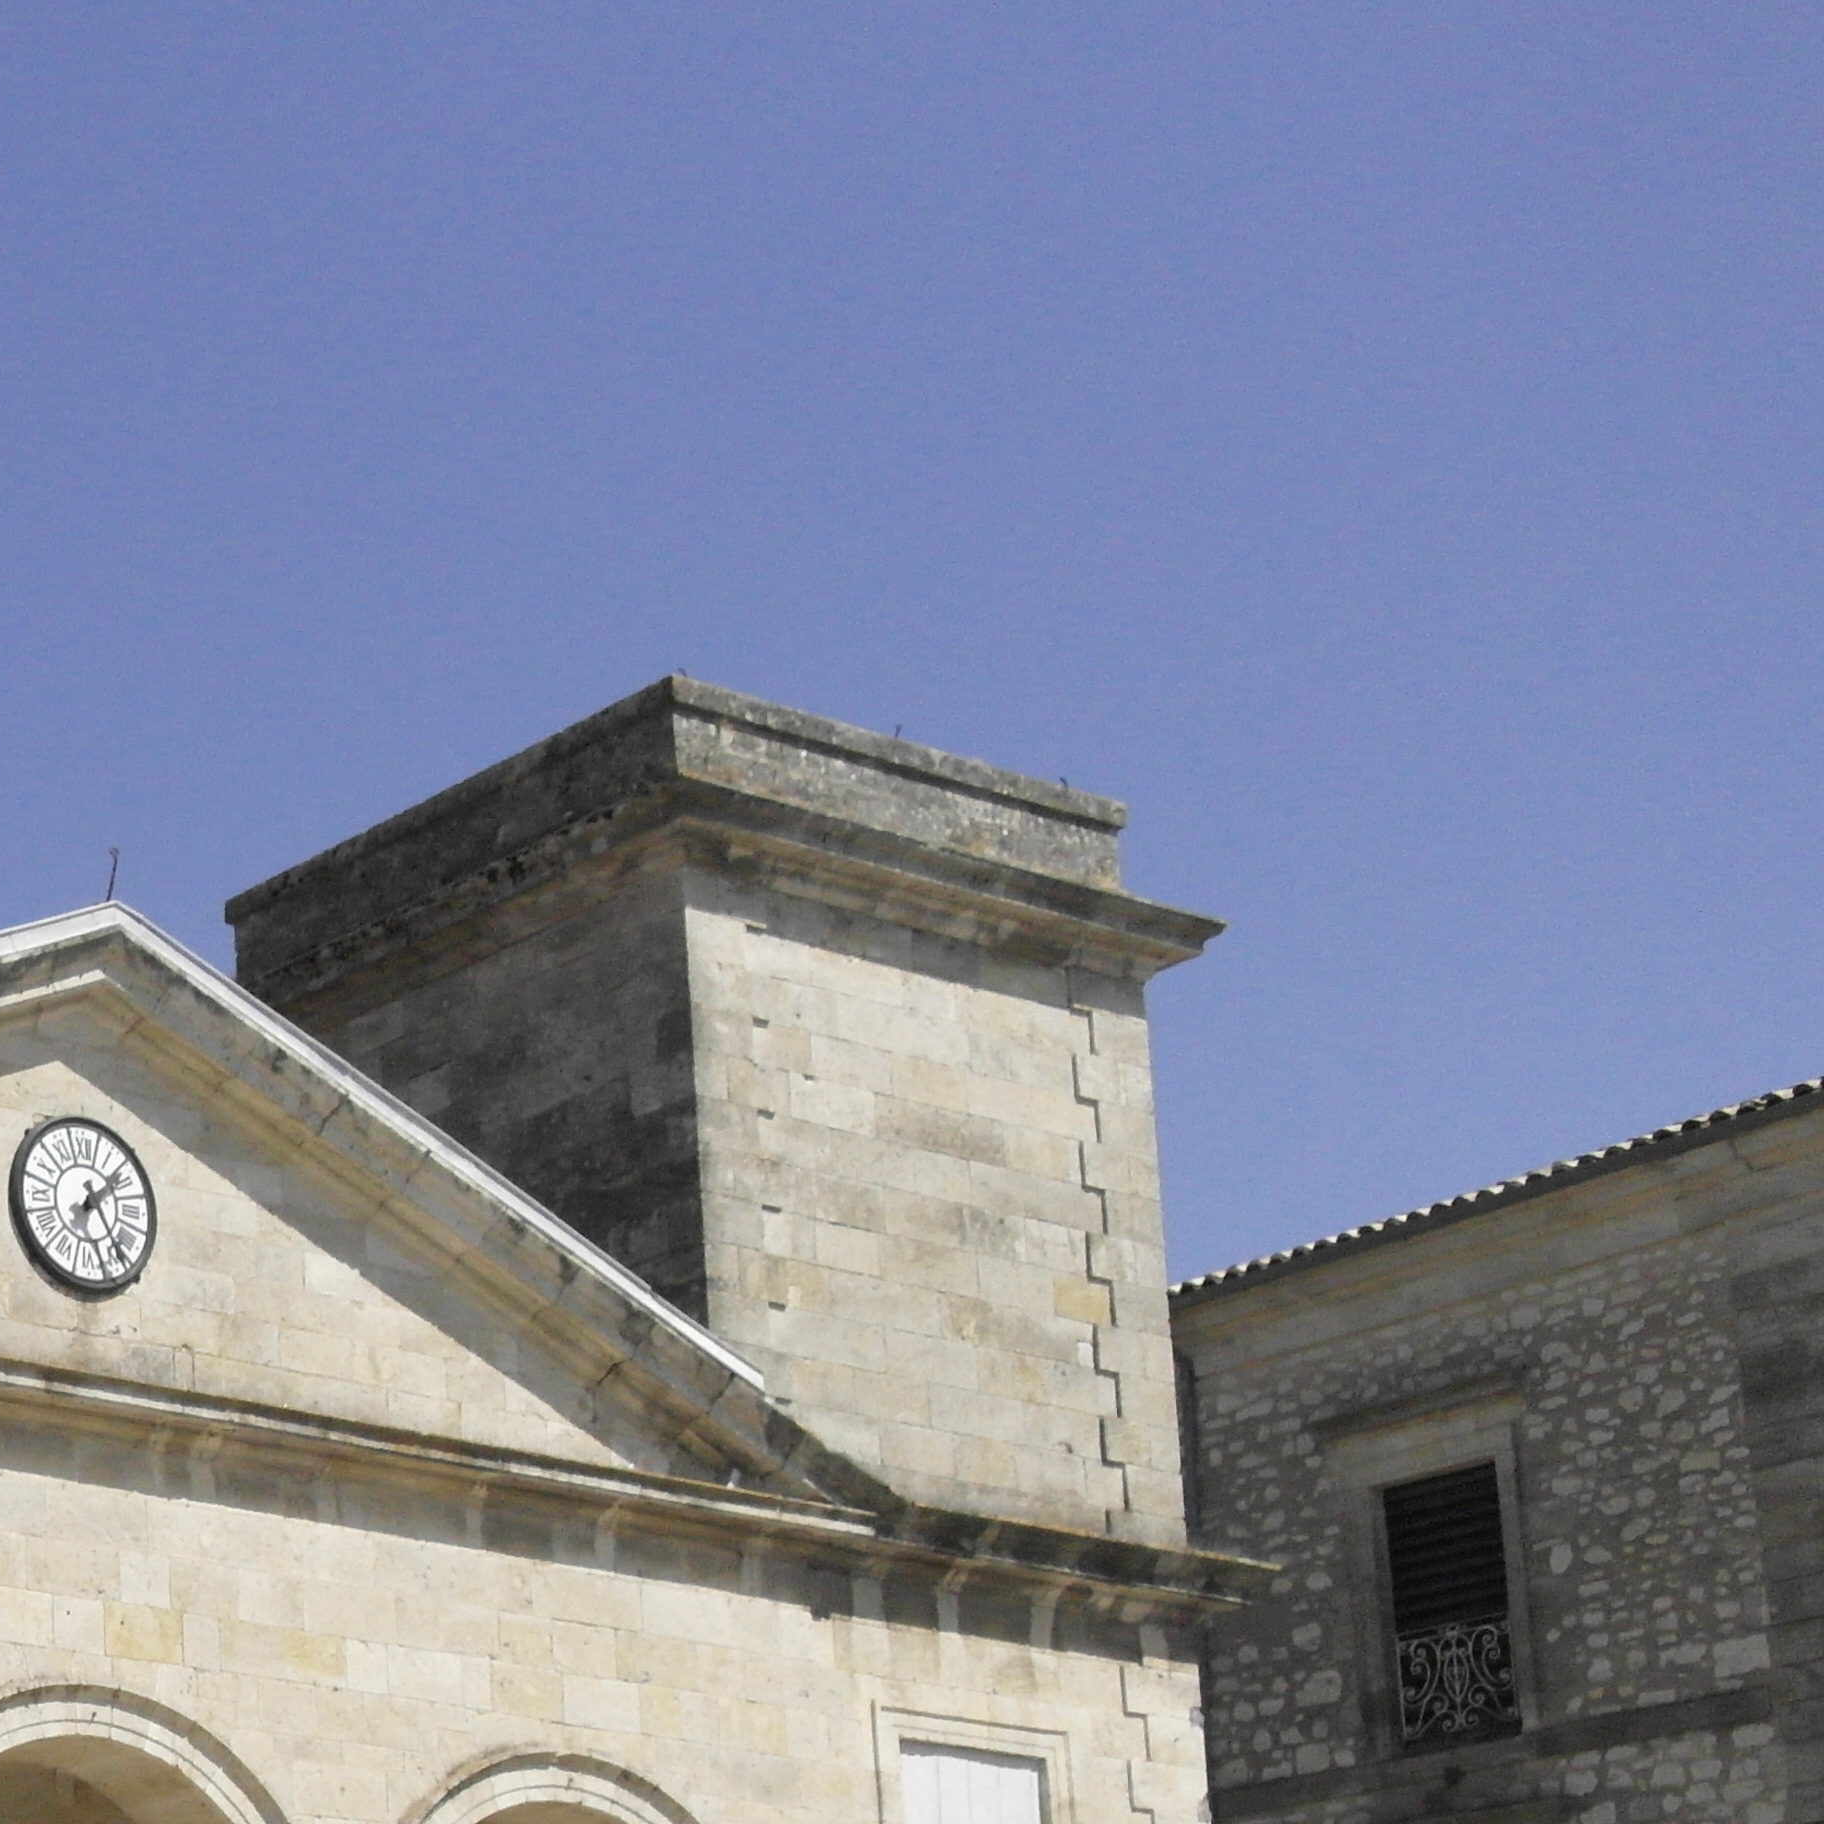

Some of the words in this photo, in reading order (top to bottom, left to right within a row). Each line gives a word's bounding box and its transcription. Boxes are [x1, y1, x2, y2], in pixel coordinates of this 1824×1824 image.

[52, 1139, 72, 1162] XI
[75, 1137, 92, 1161] XII
[37, 1158, 56, 1178] X
[32, 1186, 50, 1202] IX
[57, 1235, 73, 1260] VII
